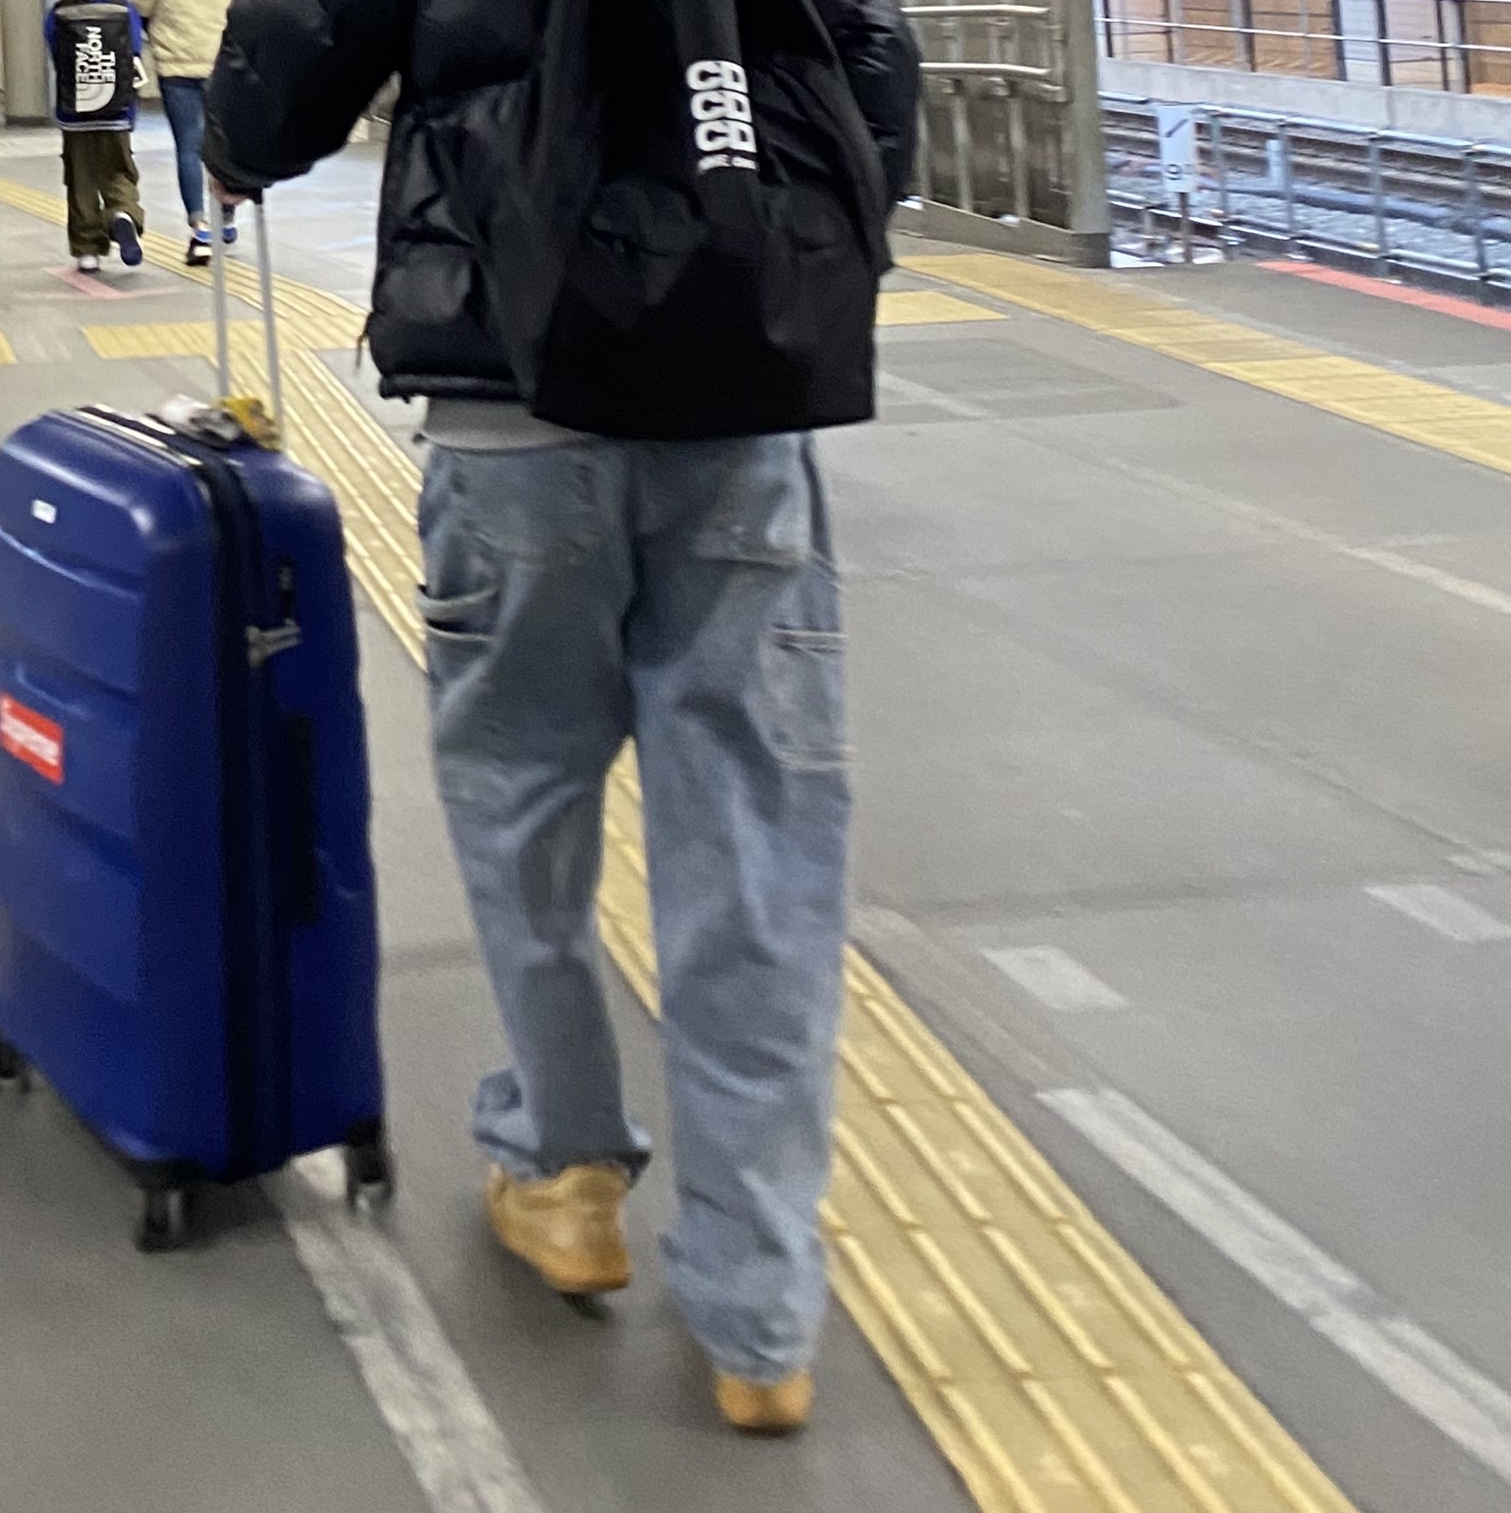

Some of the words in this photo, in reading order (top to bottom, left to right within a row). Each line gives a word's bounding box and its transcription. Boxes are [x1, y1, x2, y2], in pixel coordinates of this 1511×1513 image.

[75, 43, 88, 83] FACE
[86, 26, 102, 83] NORTH
[100, 50, 116, 83] THE
